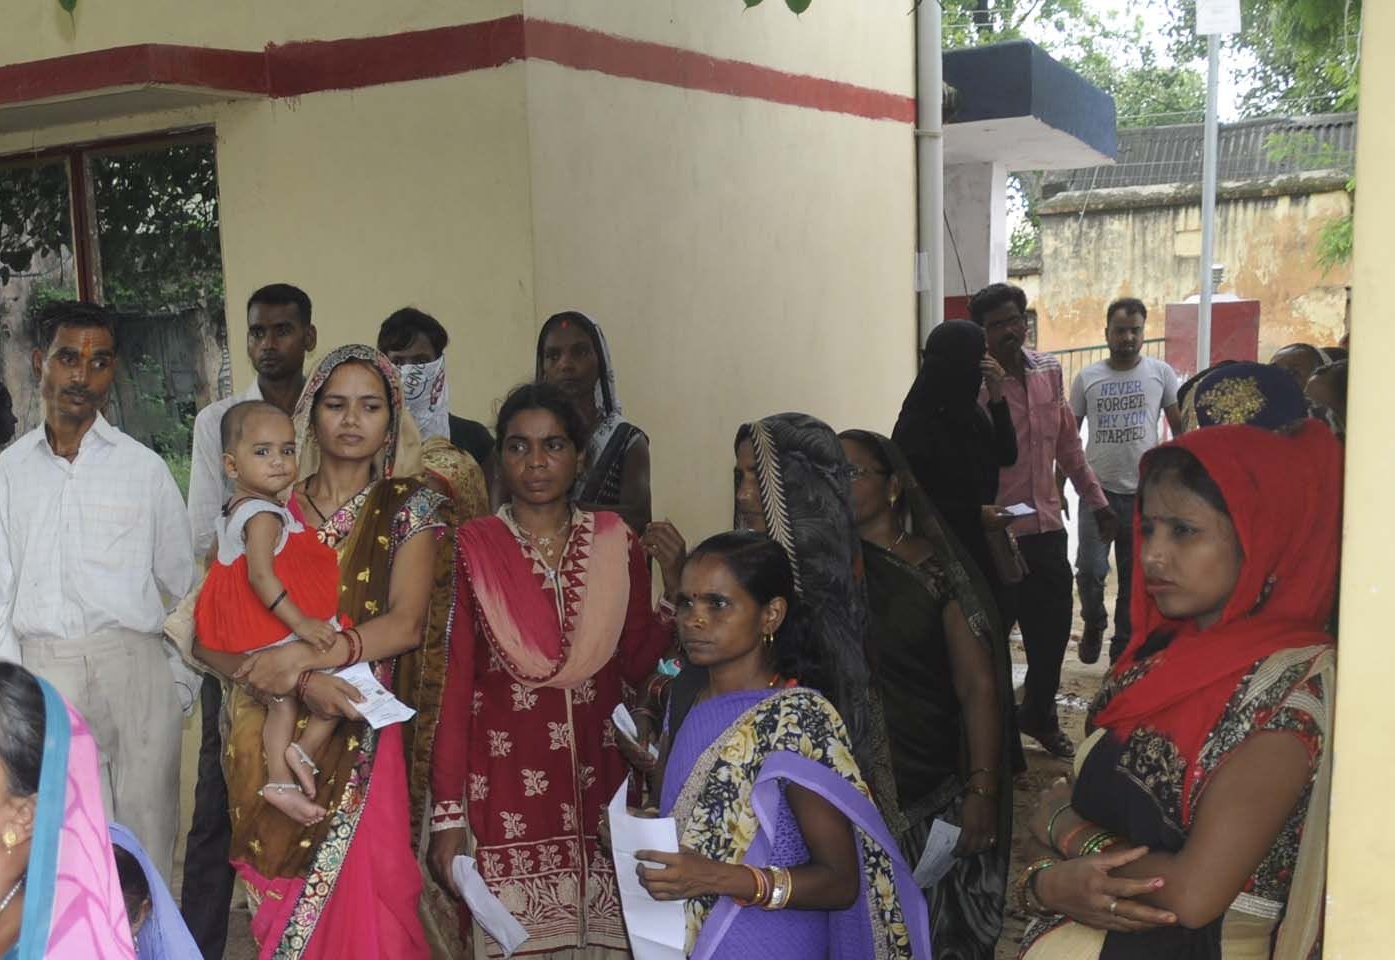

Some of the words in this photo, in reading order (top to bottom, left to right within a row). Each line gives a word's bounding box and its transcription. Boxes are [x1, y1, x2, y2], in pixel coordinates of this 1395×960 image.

[1100, 380, 1142, 396] NEVER
[1096, 393, 1146, 412] FORGET
[1098, 413, 1119, 428] WHY
[1123, 411, 1148, 427] YOU
[1095, 426, 1146, 443] STARTED
